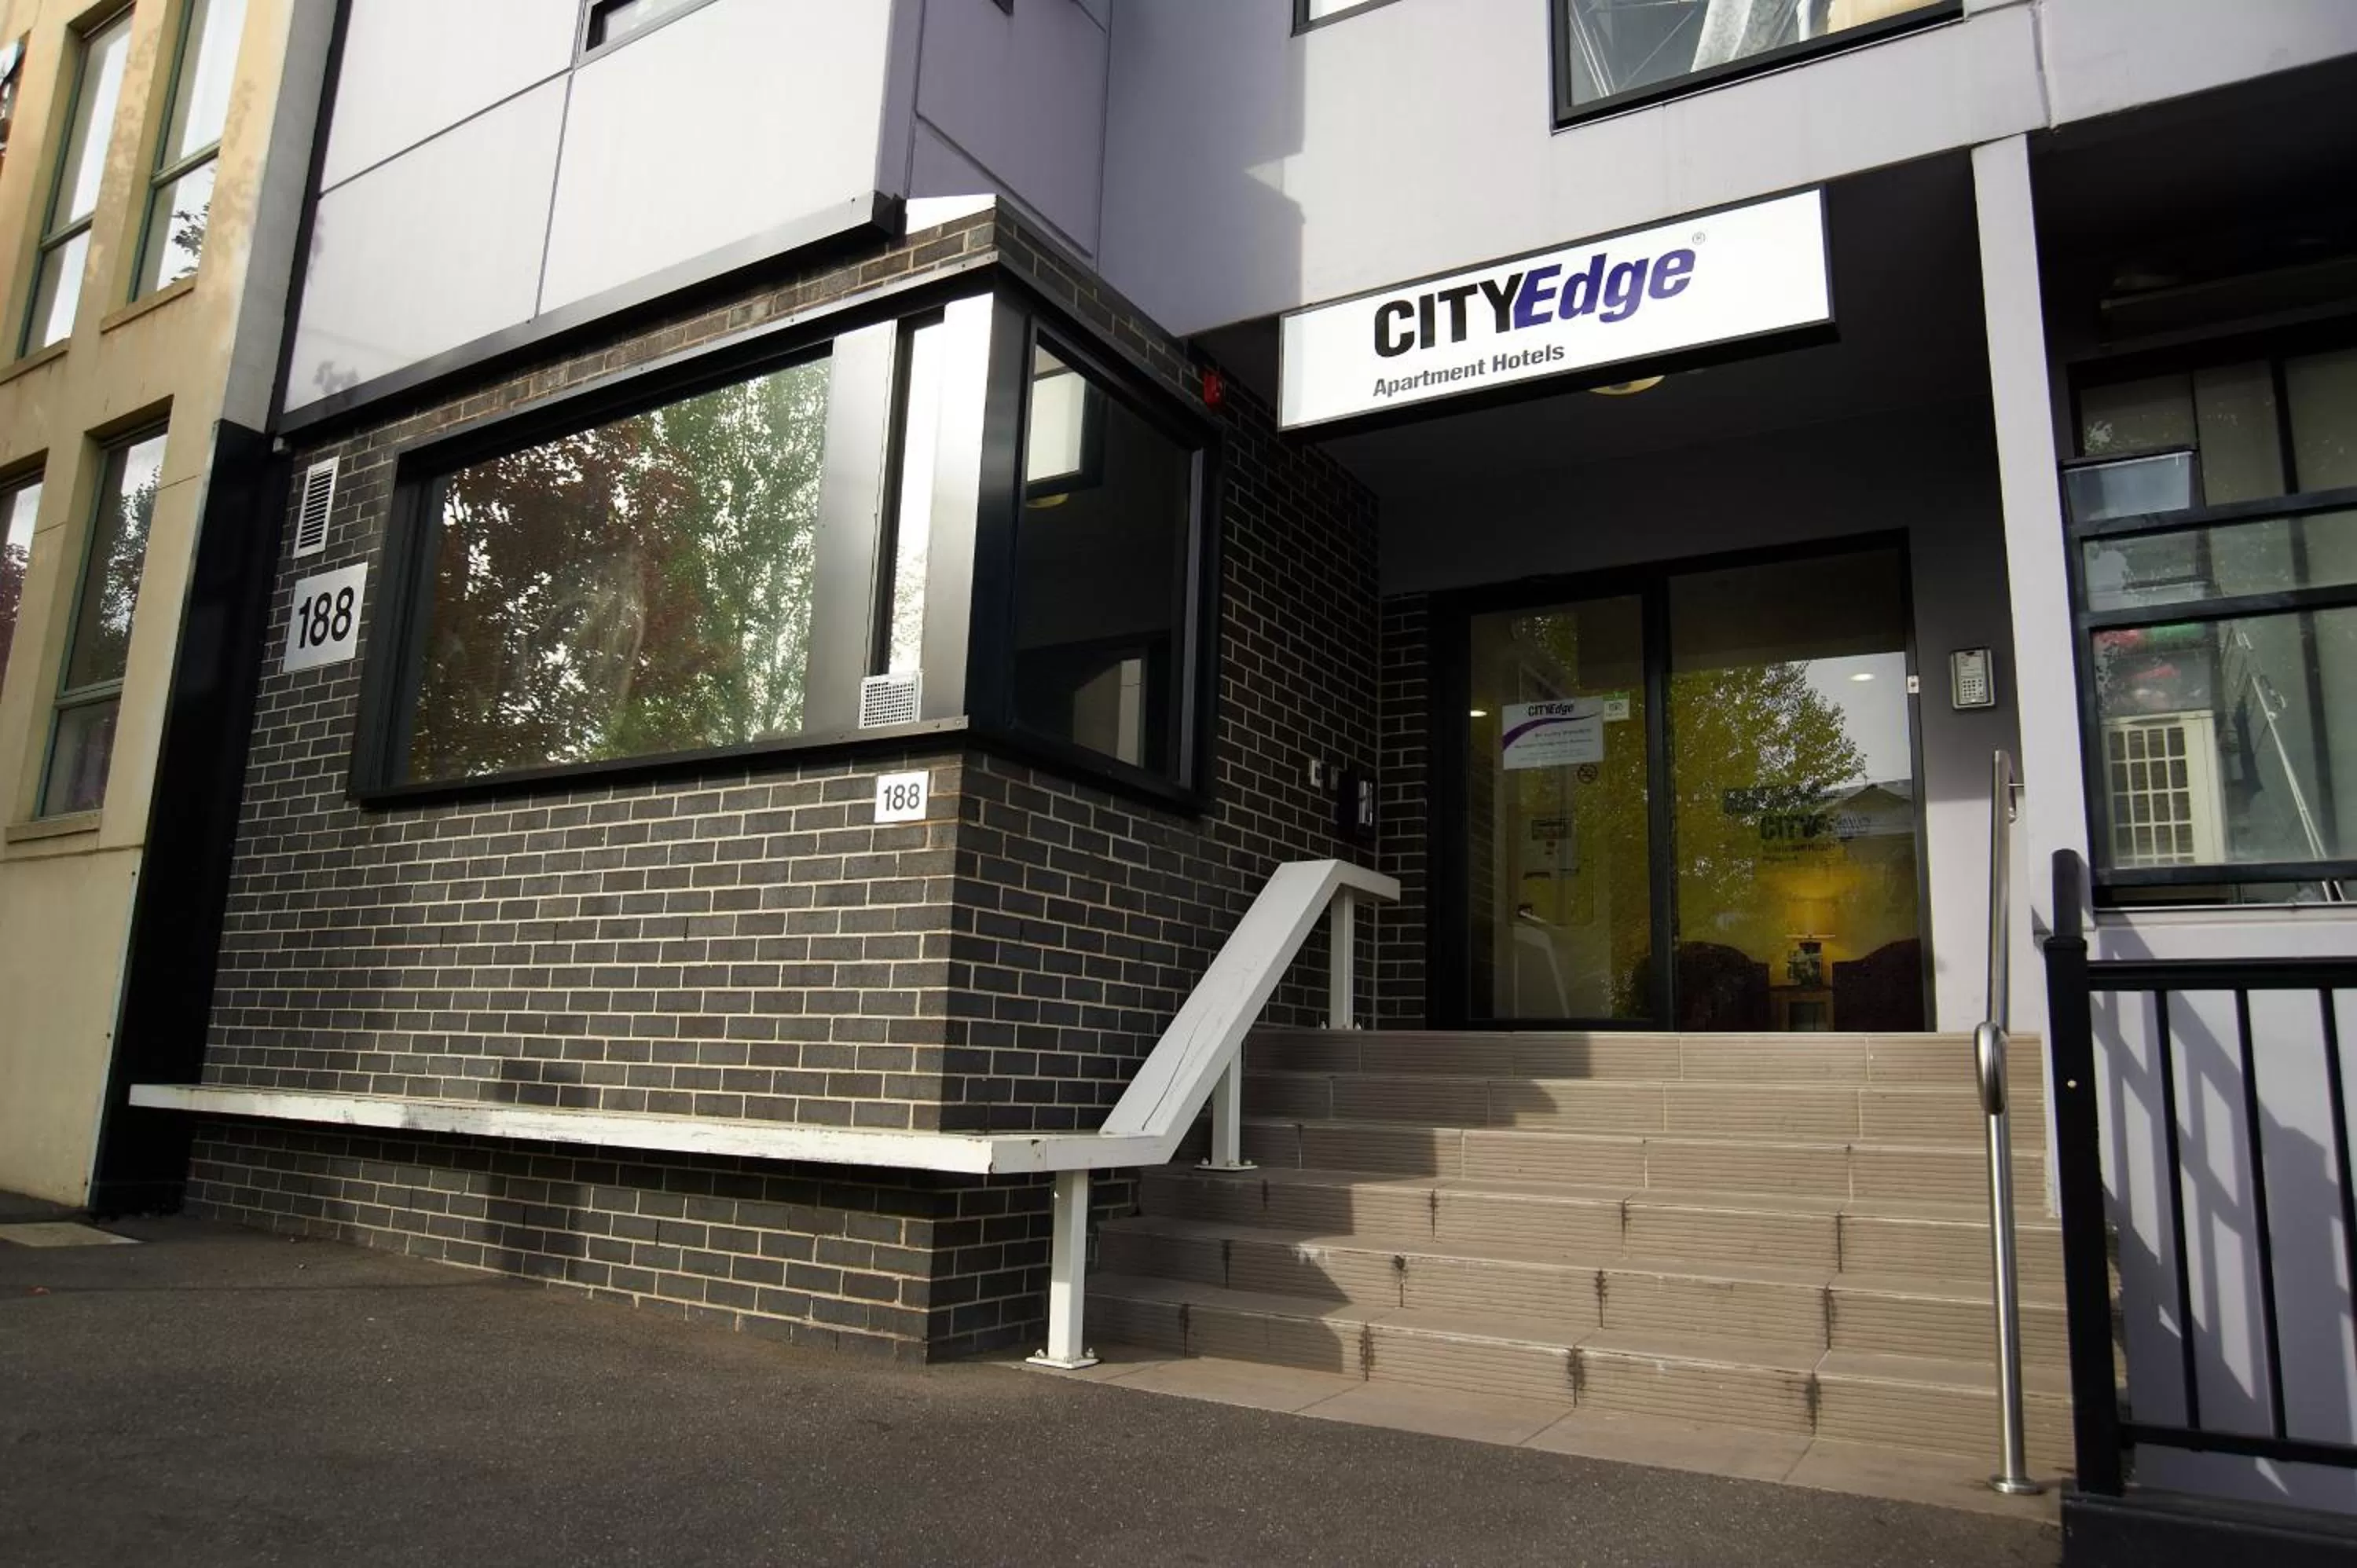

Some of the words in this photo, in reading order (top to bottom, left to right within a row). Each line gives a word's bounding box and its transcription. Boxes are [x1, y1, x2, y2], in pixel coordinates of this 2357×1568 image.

[1375, 248, 1695, 357] CITYEdge
[1373, 359, 1486, 397] Apartment
[1492, 344, 1565, 373] Hotels
[299, 586, 354, 649] 188
[883, 782, 920, 811] 188
